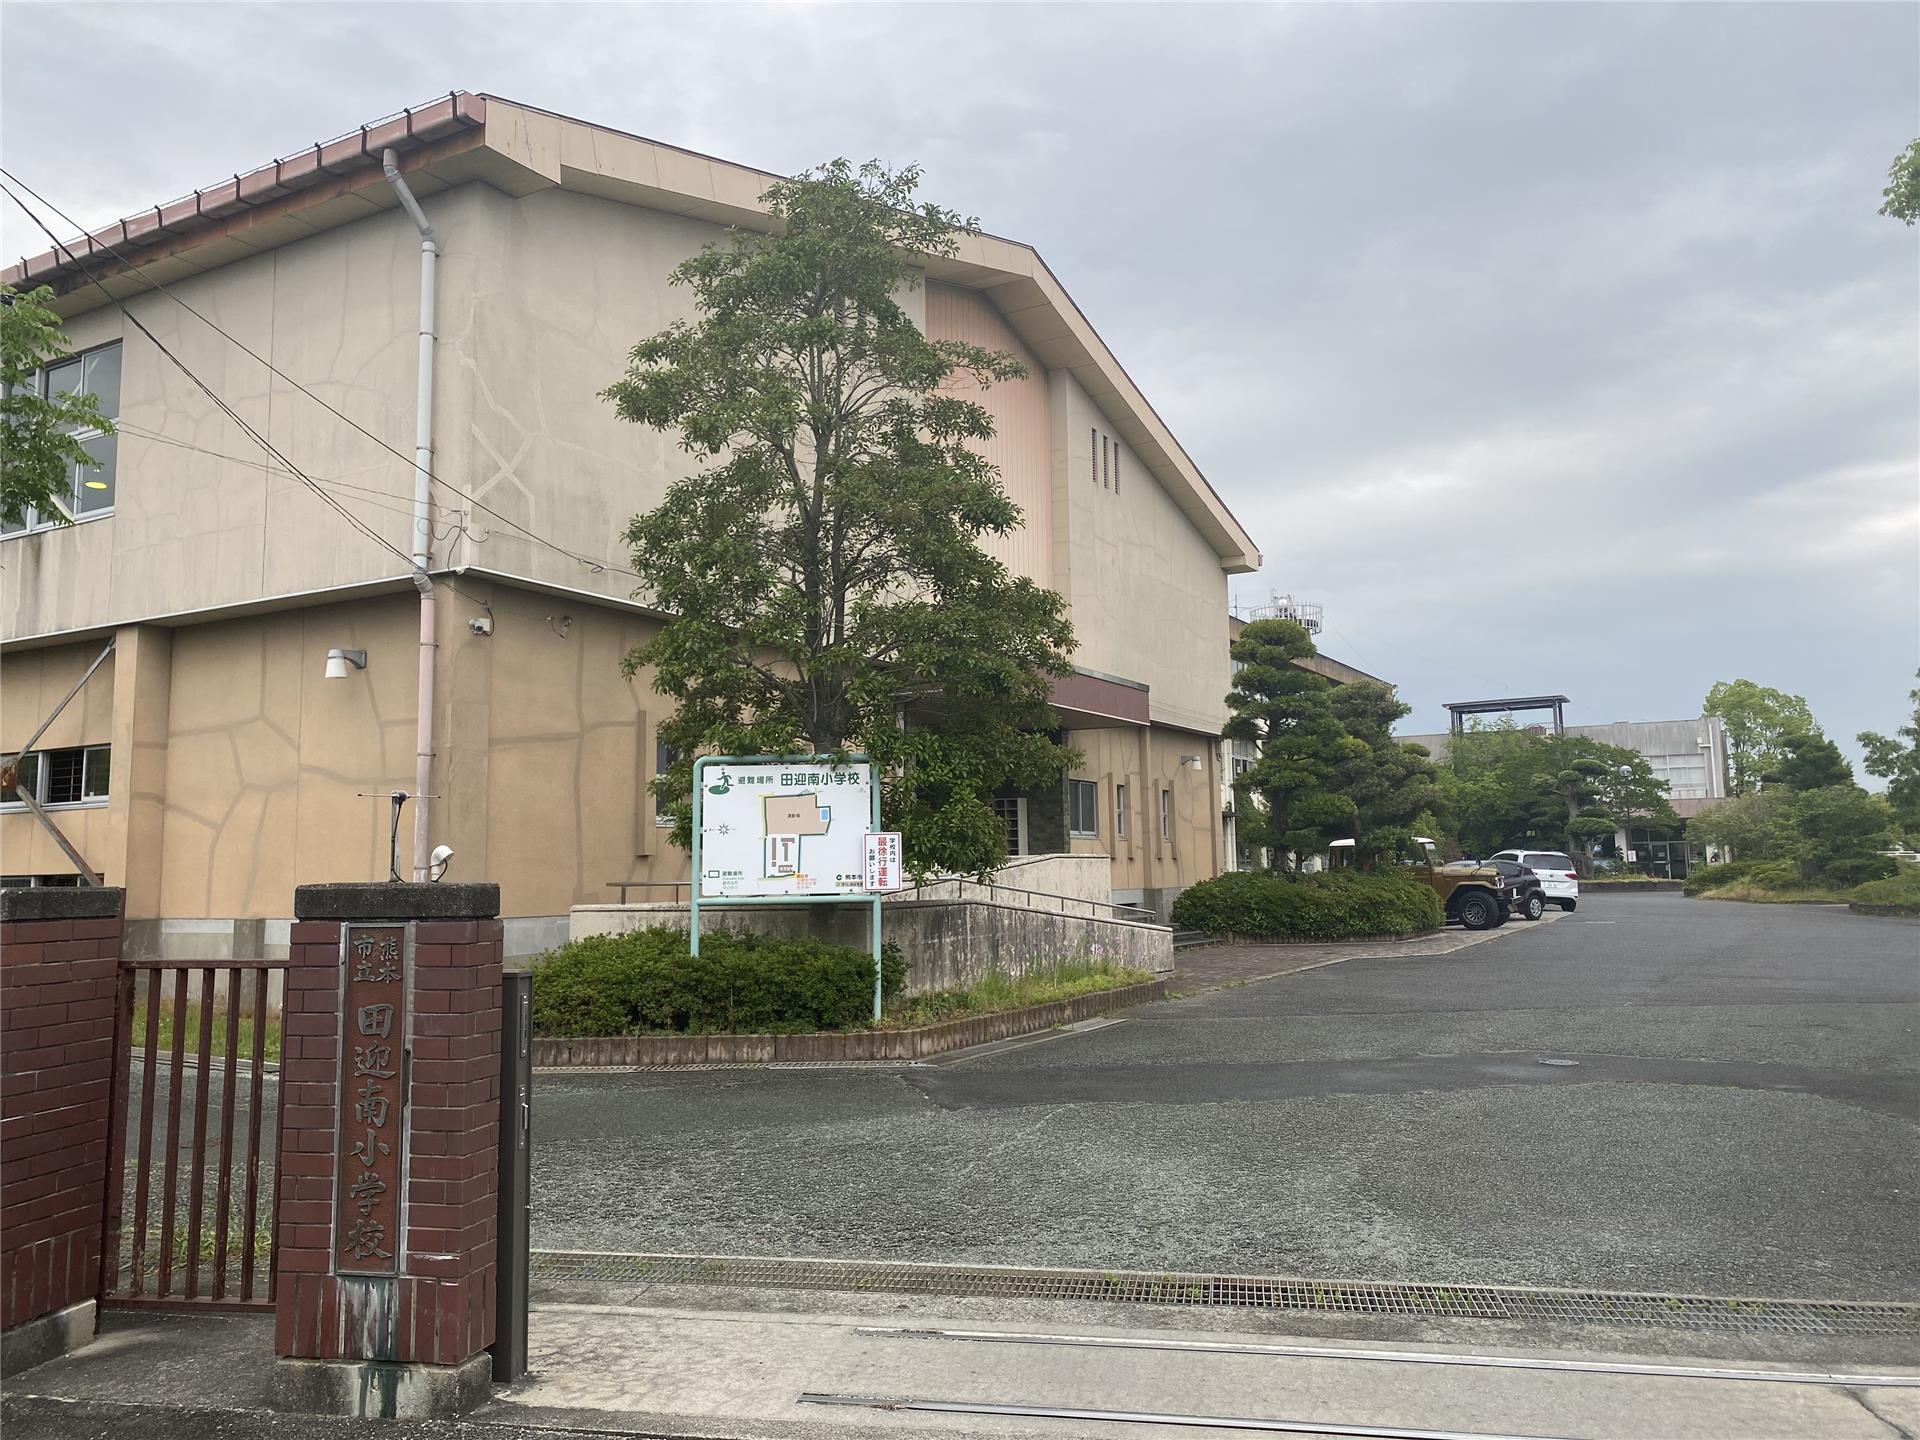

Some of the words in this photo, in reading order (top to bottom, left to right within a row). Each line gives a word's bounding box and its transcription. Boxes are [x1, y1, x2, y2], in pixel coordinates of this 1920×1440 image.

[738, 776, 774, 784] 避難場所
[781, 772, 860, 786] 田迎南小学校
[878, 837, 887, 886] 最徐行運転
[353, 934, 376, 982] 市立
[375, 936, 402, 984] 熊本
[345, 1003, 397, 1260] 田迎南小学校
